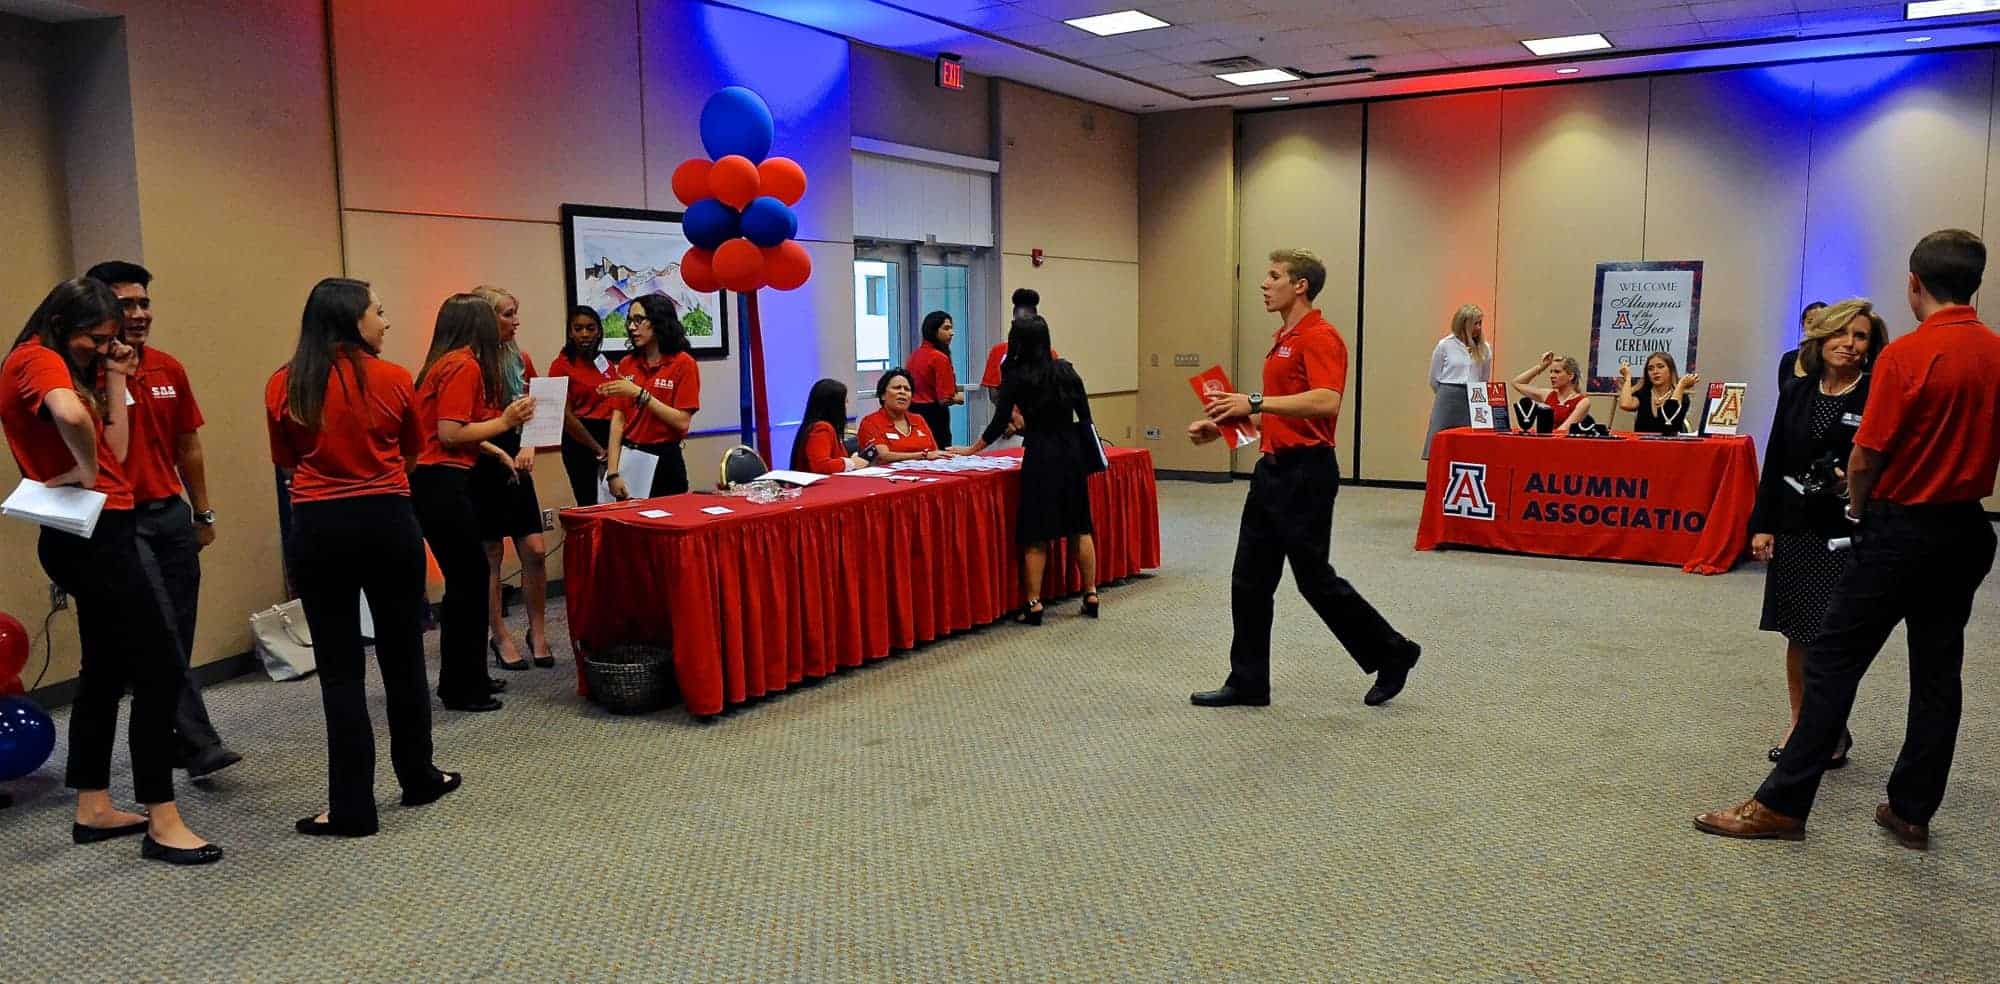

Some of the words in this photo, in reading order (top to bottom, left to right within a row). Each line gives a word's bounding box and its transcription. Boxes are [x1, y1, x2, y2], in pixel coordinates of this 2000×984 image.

[943, 61, 960, 87] EXIT
[1619, 282, 1678, 292] WELCOME
[1610, 294, 1681, 309] Alumnus
[1612, 310, 1632, 329] A
[1632, 318, 1675, 336] Year
[1615, 338, 1672, 352] CEREMONY
[1443, 461, 1495, 520] A
[1525, 472, 1648, 499] ALUMNI
[1523, 501, 1705, 532] ASSOCIATIO
